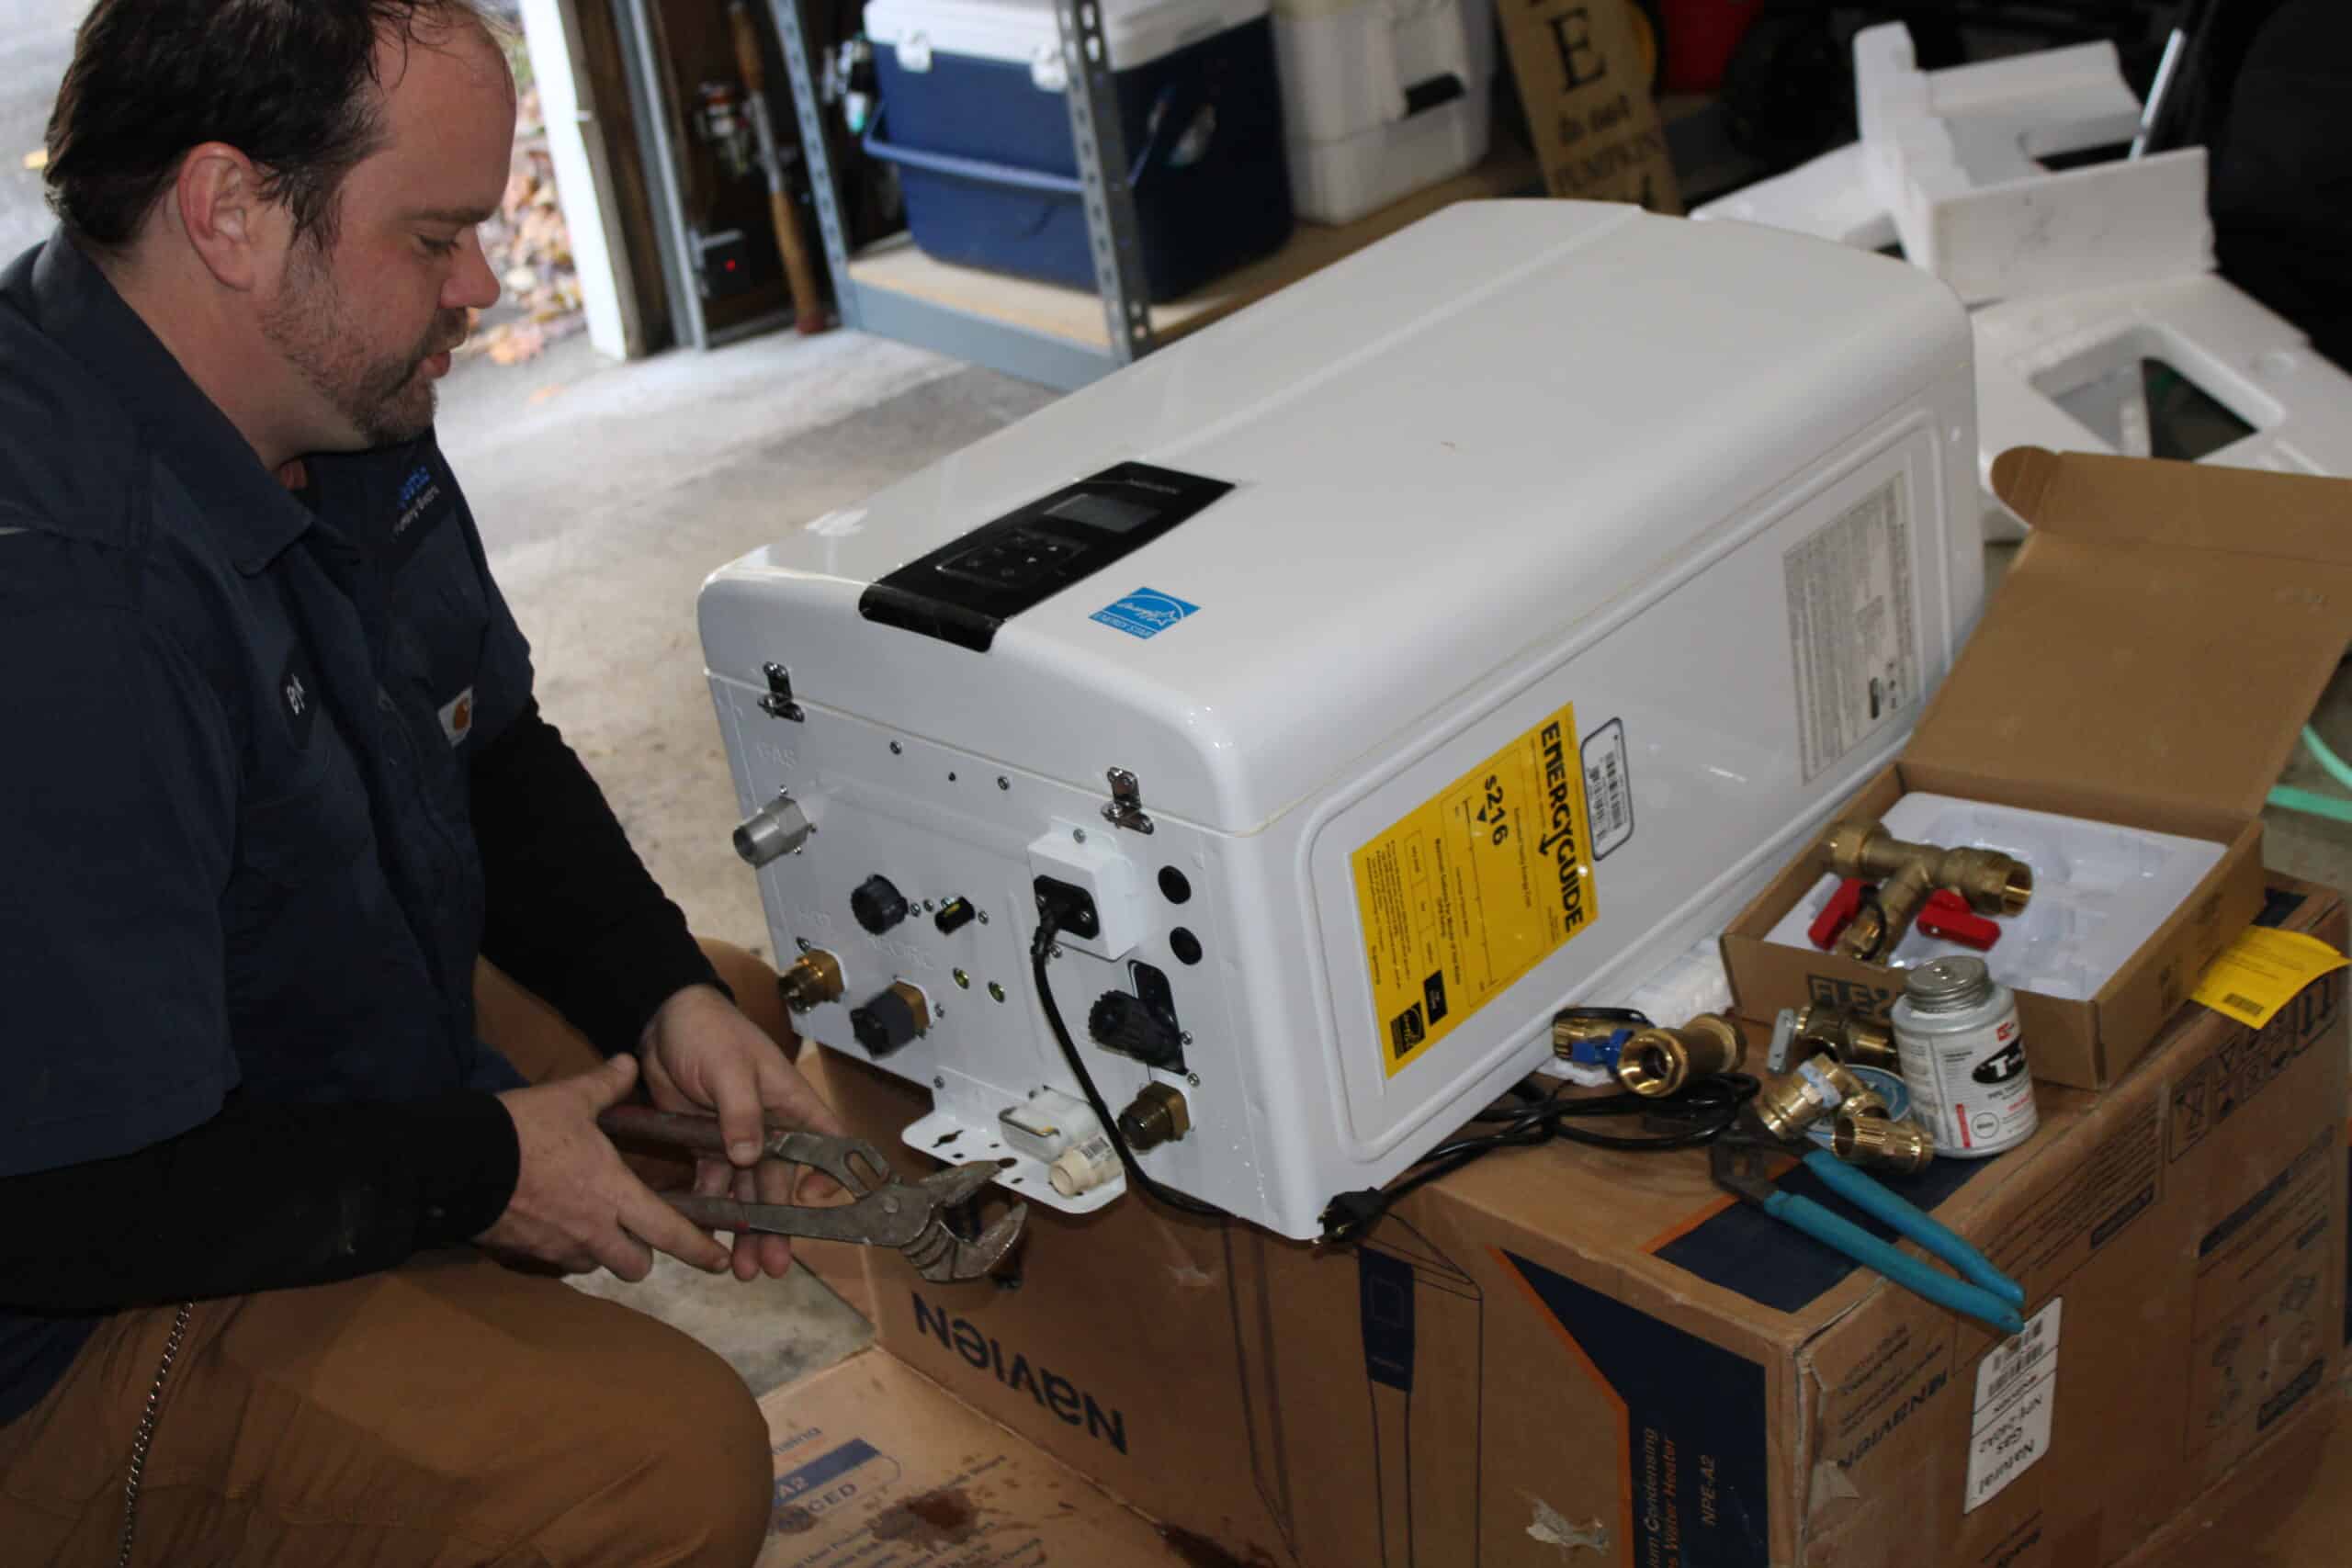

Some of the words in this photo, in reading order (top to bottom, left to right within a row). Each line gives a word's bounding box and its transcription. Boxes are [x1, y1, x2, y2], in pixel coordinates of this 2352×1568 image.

[1546, 8, 1608, 93] E
[1484, 773, 1510, 848] $216
[1540, 719, 1585, 934] ENERGYGUIDE
[1645, 1427, 1661, 1533] Condensing
[1978, 1438, 2035, 1495] Natural
